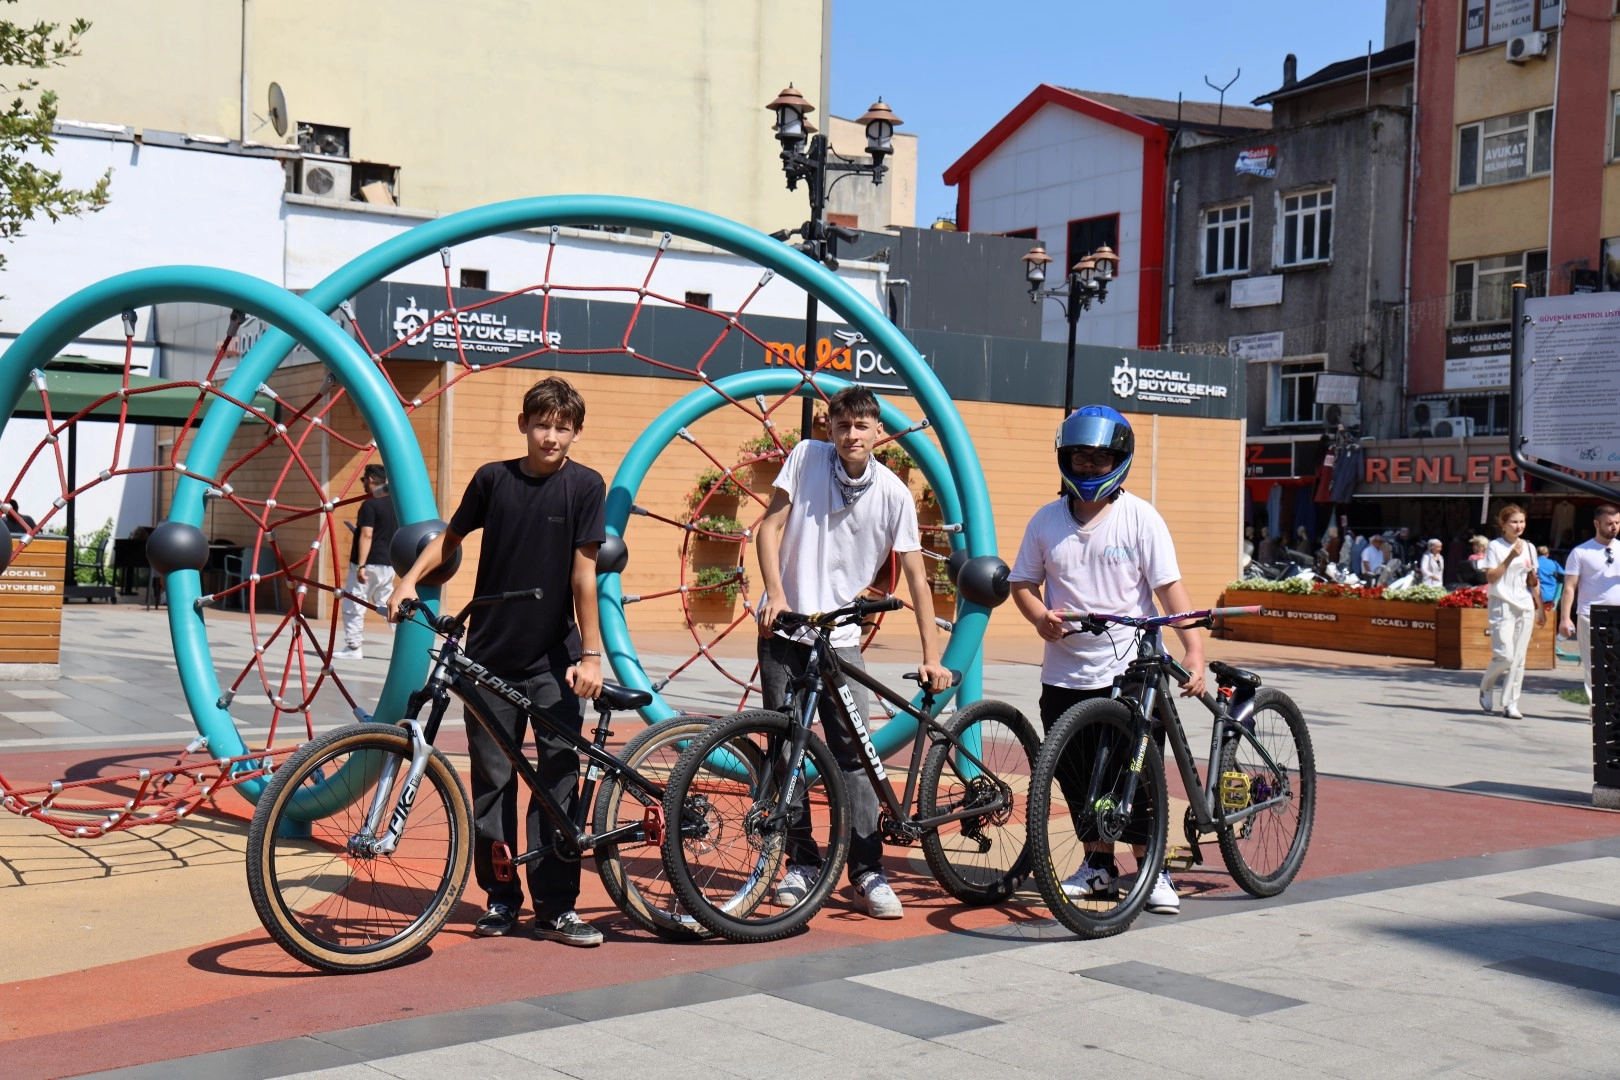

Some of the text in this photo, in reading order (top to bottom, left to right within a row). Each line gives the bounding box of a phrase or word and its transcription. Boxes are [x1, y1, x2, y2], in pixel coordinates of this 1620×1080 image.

[1485, 142, 1525, 161] AVUKAT
[1539, 313, 1572, 323] GÜVENLİK
[1573, 310, 1603, 320] KONTROL
[1138, 379, 1227, 398] BÜYÜKŞEHİR
[1366, 455, 1519, 483] RENLER
[0, 584, 56, 592] ÜYÜKŞEHİR
[465, 661, 532, 709] PLAYER
[838, 684, 887, 781] Bianchi
